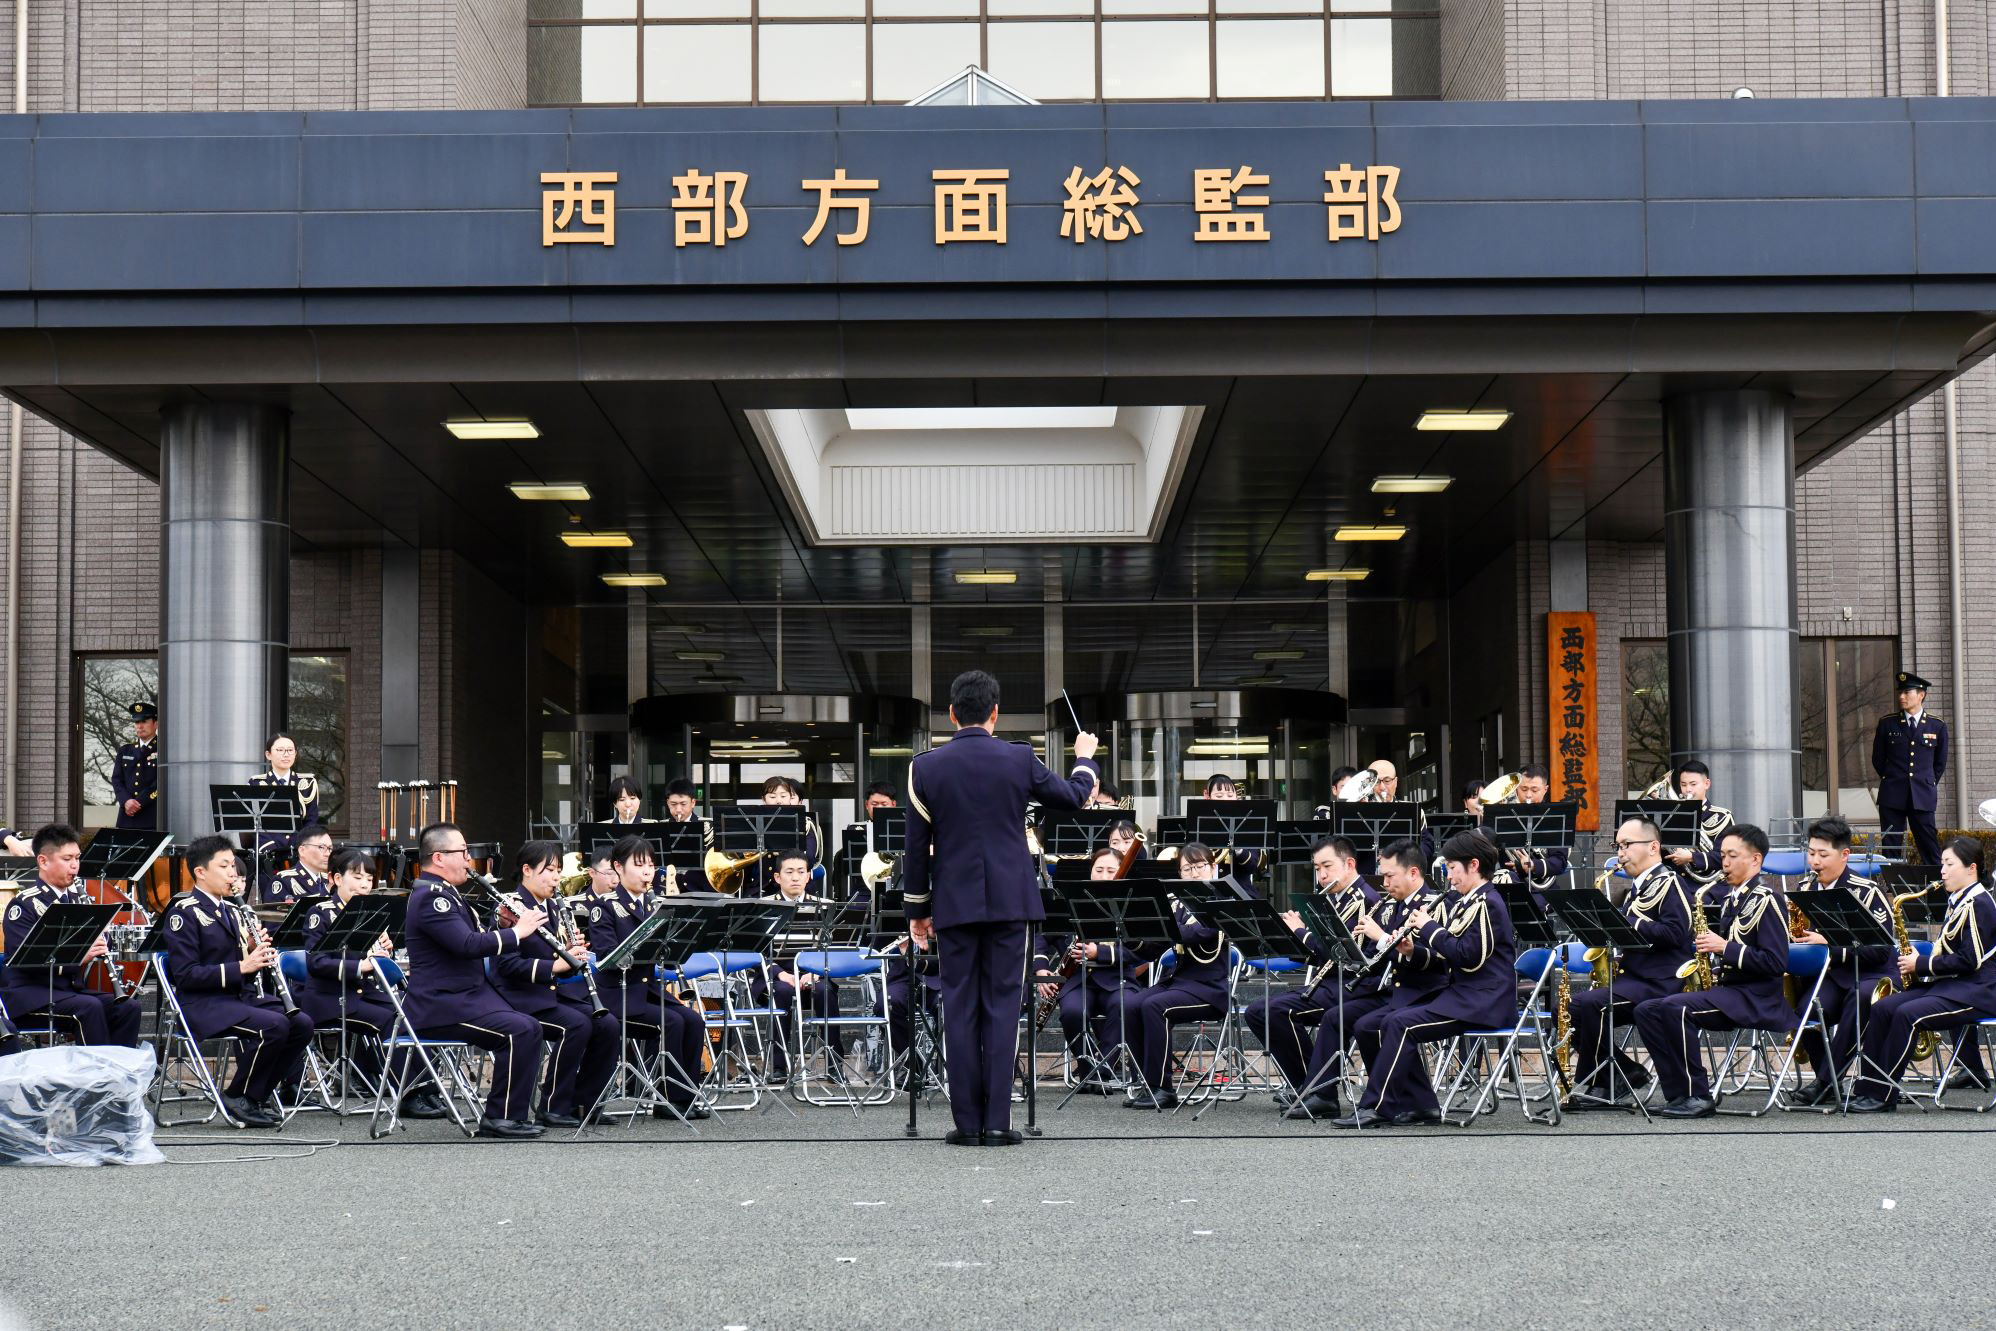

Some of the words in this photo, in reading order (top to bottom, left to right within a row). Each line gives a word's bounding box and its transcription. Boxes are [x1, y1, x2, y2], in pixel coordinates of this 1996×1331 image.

[540, 163, 1402, 247] 西部方面総監部
